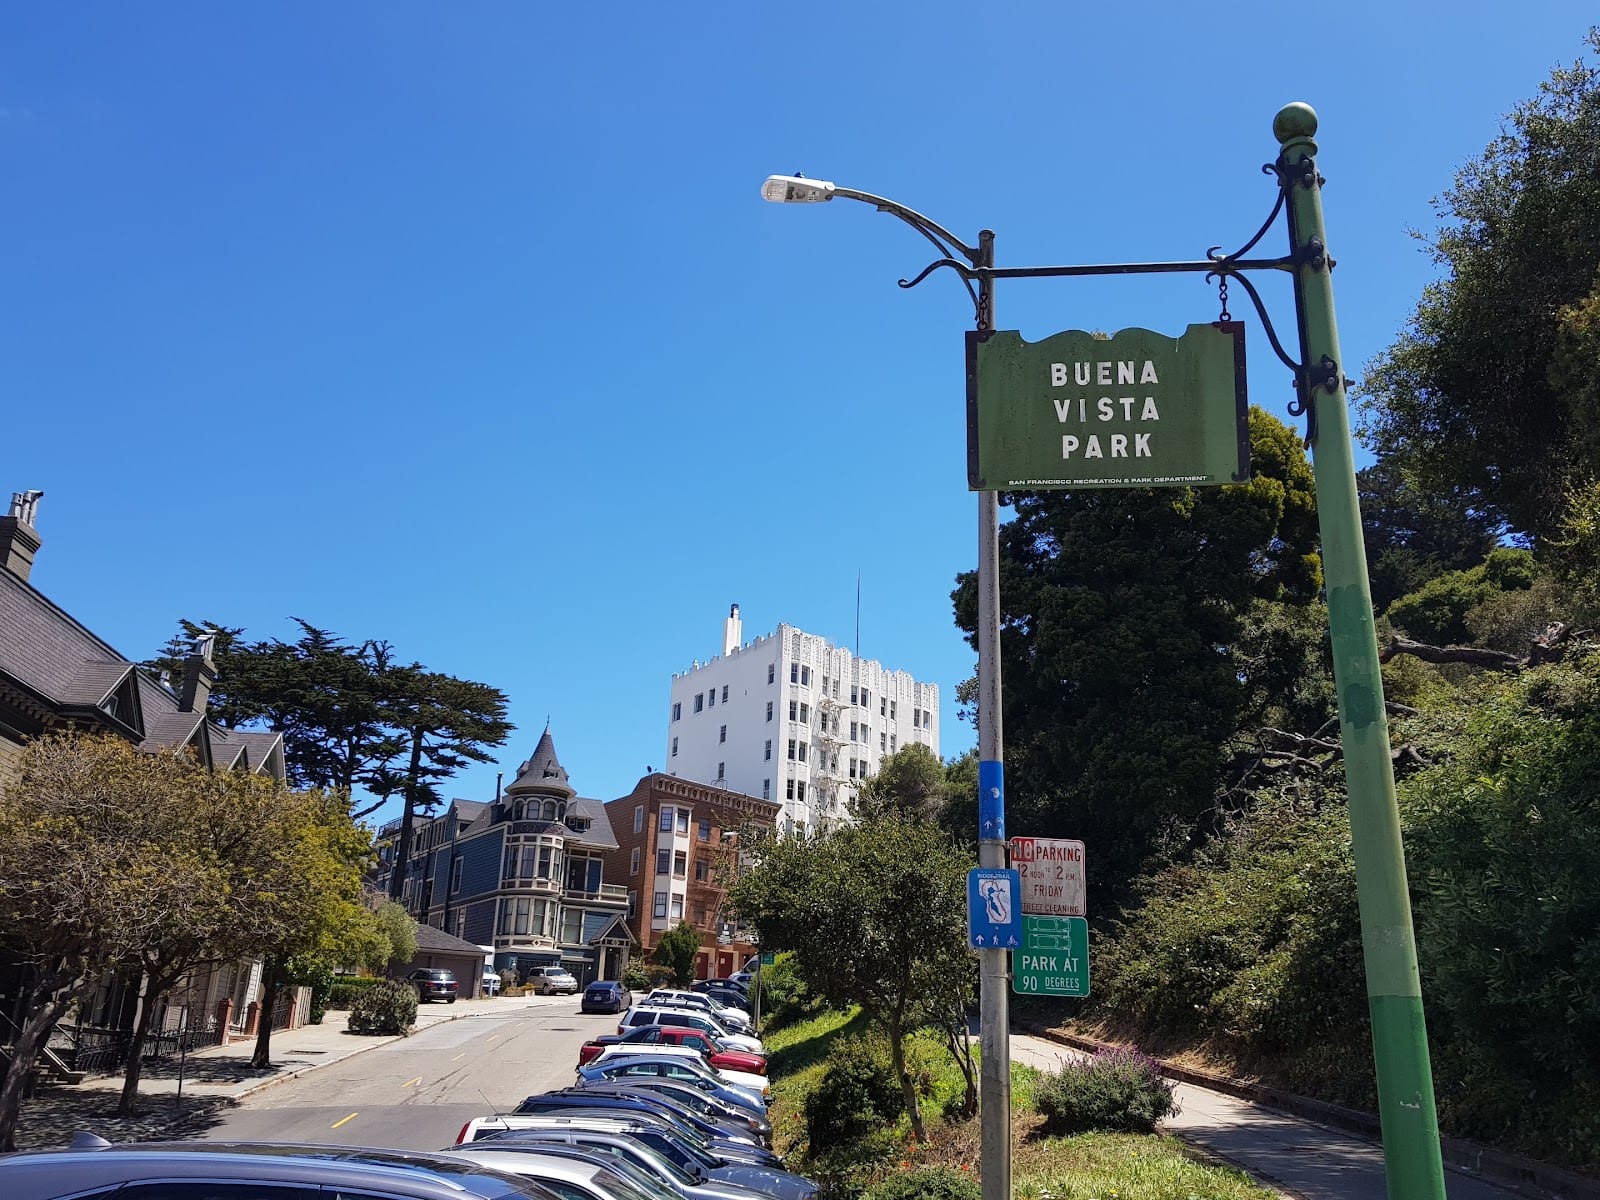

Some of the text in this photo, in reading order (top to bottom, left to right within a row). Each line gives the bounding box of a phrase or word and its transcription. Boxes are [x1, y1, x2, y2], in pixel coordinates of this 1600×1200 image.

[1050, 360, 1159, 387] BUENA
[1053, 396, 1160, 423] VISTA
[1062, 433, 1152, 459] PARK
[1154, 475, 1208, 483] DEPARTMENT
[1012, 840, 1081, 862] NO PARKING
[1017, 863, 1029, 878] 12
[1030, 871, 1045, 879] NOON
[1056, 866, 1064, 880] 2
[1034, 884, 1064, 898] FRIDAY
[1022, 902, 1079, 914] TREET CLEANING
[1022, 955, 1079, 972] PARK AT
[1022, 975, 1080, 991] 90 DEGREES
